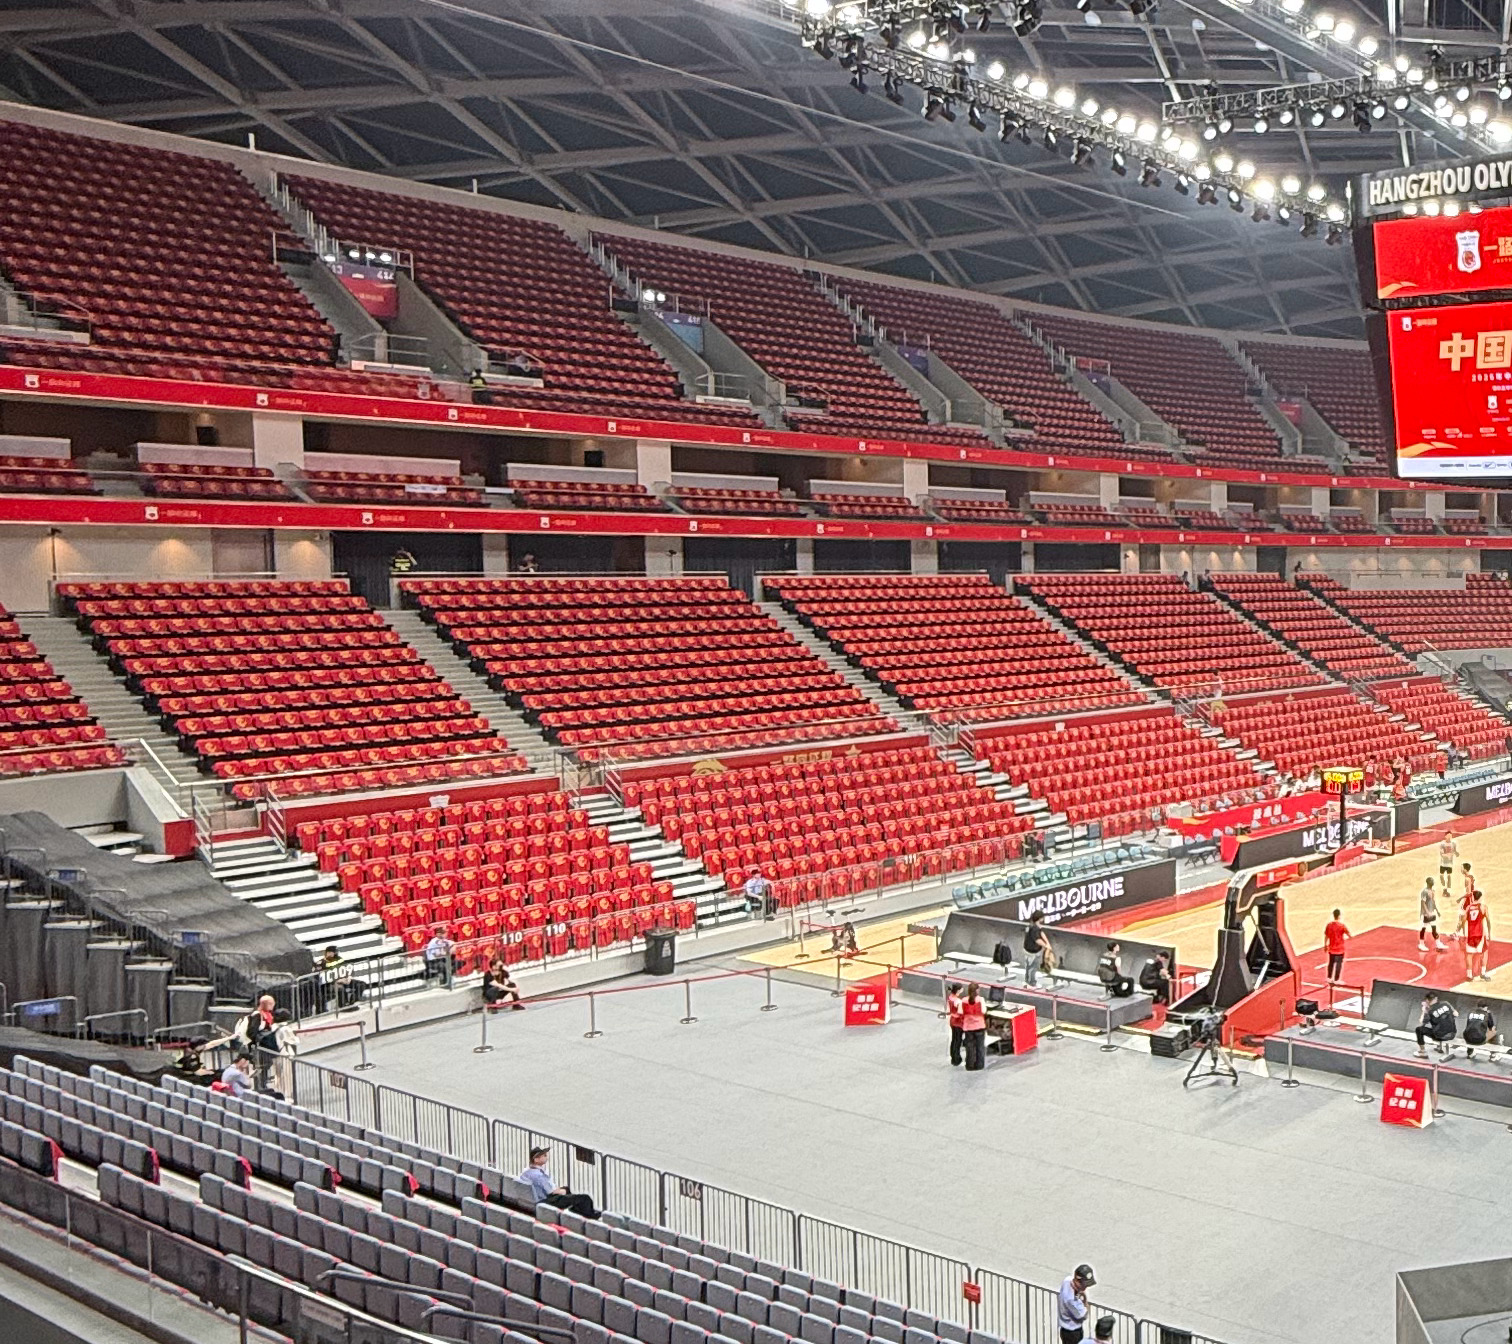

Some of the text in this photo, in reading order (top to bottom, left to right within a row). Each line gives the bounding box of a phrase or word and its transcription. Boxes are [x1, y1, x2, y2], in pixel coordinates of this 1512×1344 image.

[1369, 163, 1472, 205] HANGZHOU
[1018, 876, 1125, 921] MELBOURNE
[501, 931, 523, 945] 110
[546, 922, 567, 937] 110
[333, 963, 354, 980] 109
[680, 1178, 701, 1201] 106
